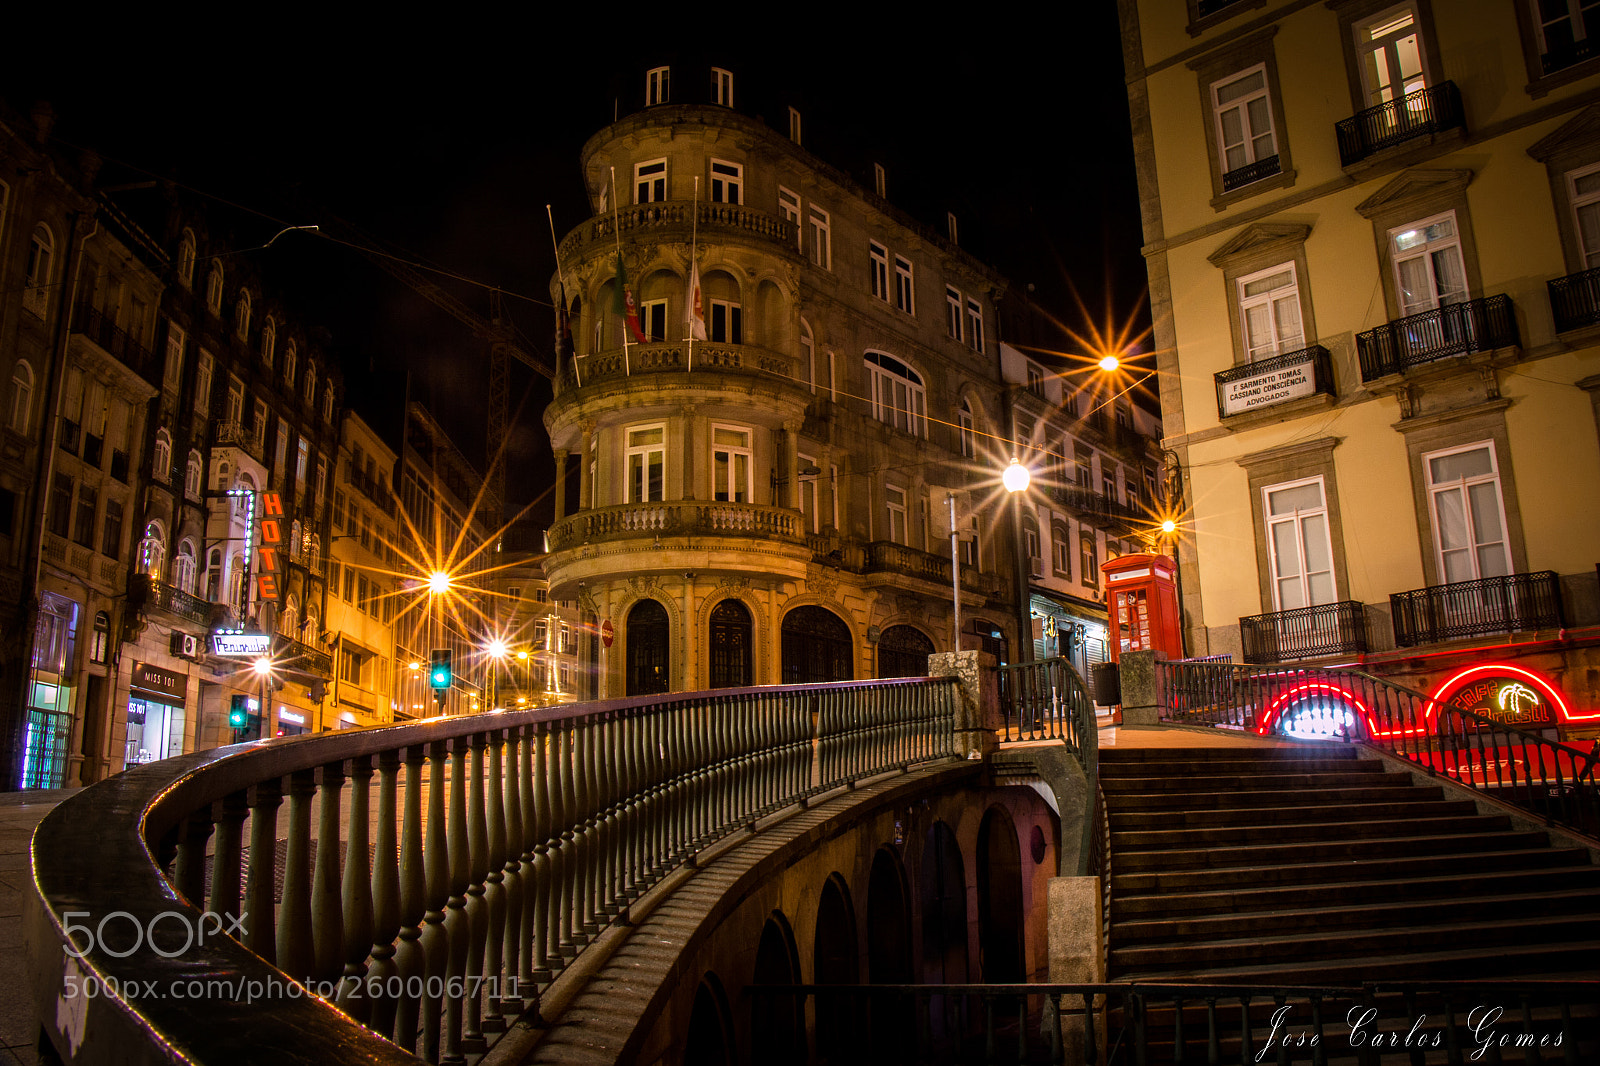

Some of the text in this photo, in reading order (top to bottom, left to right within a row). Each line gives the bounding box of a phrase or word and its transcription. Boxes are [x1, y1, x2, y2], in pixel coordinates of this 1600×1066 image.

[1230, 376, 1307, 400] CASSIANO CONSCIÊNCIA
[1240, 375, 1275, 390] SARMENTO
[1278, 368, 1302, 381] TOMAS
[1247, 391, 1289, 406] ADVOGADOS
[257, 493, 283, 604] HOTE
[145, 672, 175, 688] MISS 101
[1451, 680, 1499, 711] CAFÉ
[1472, 703, 1550, 728] Brasil
